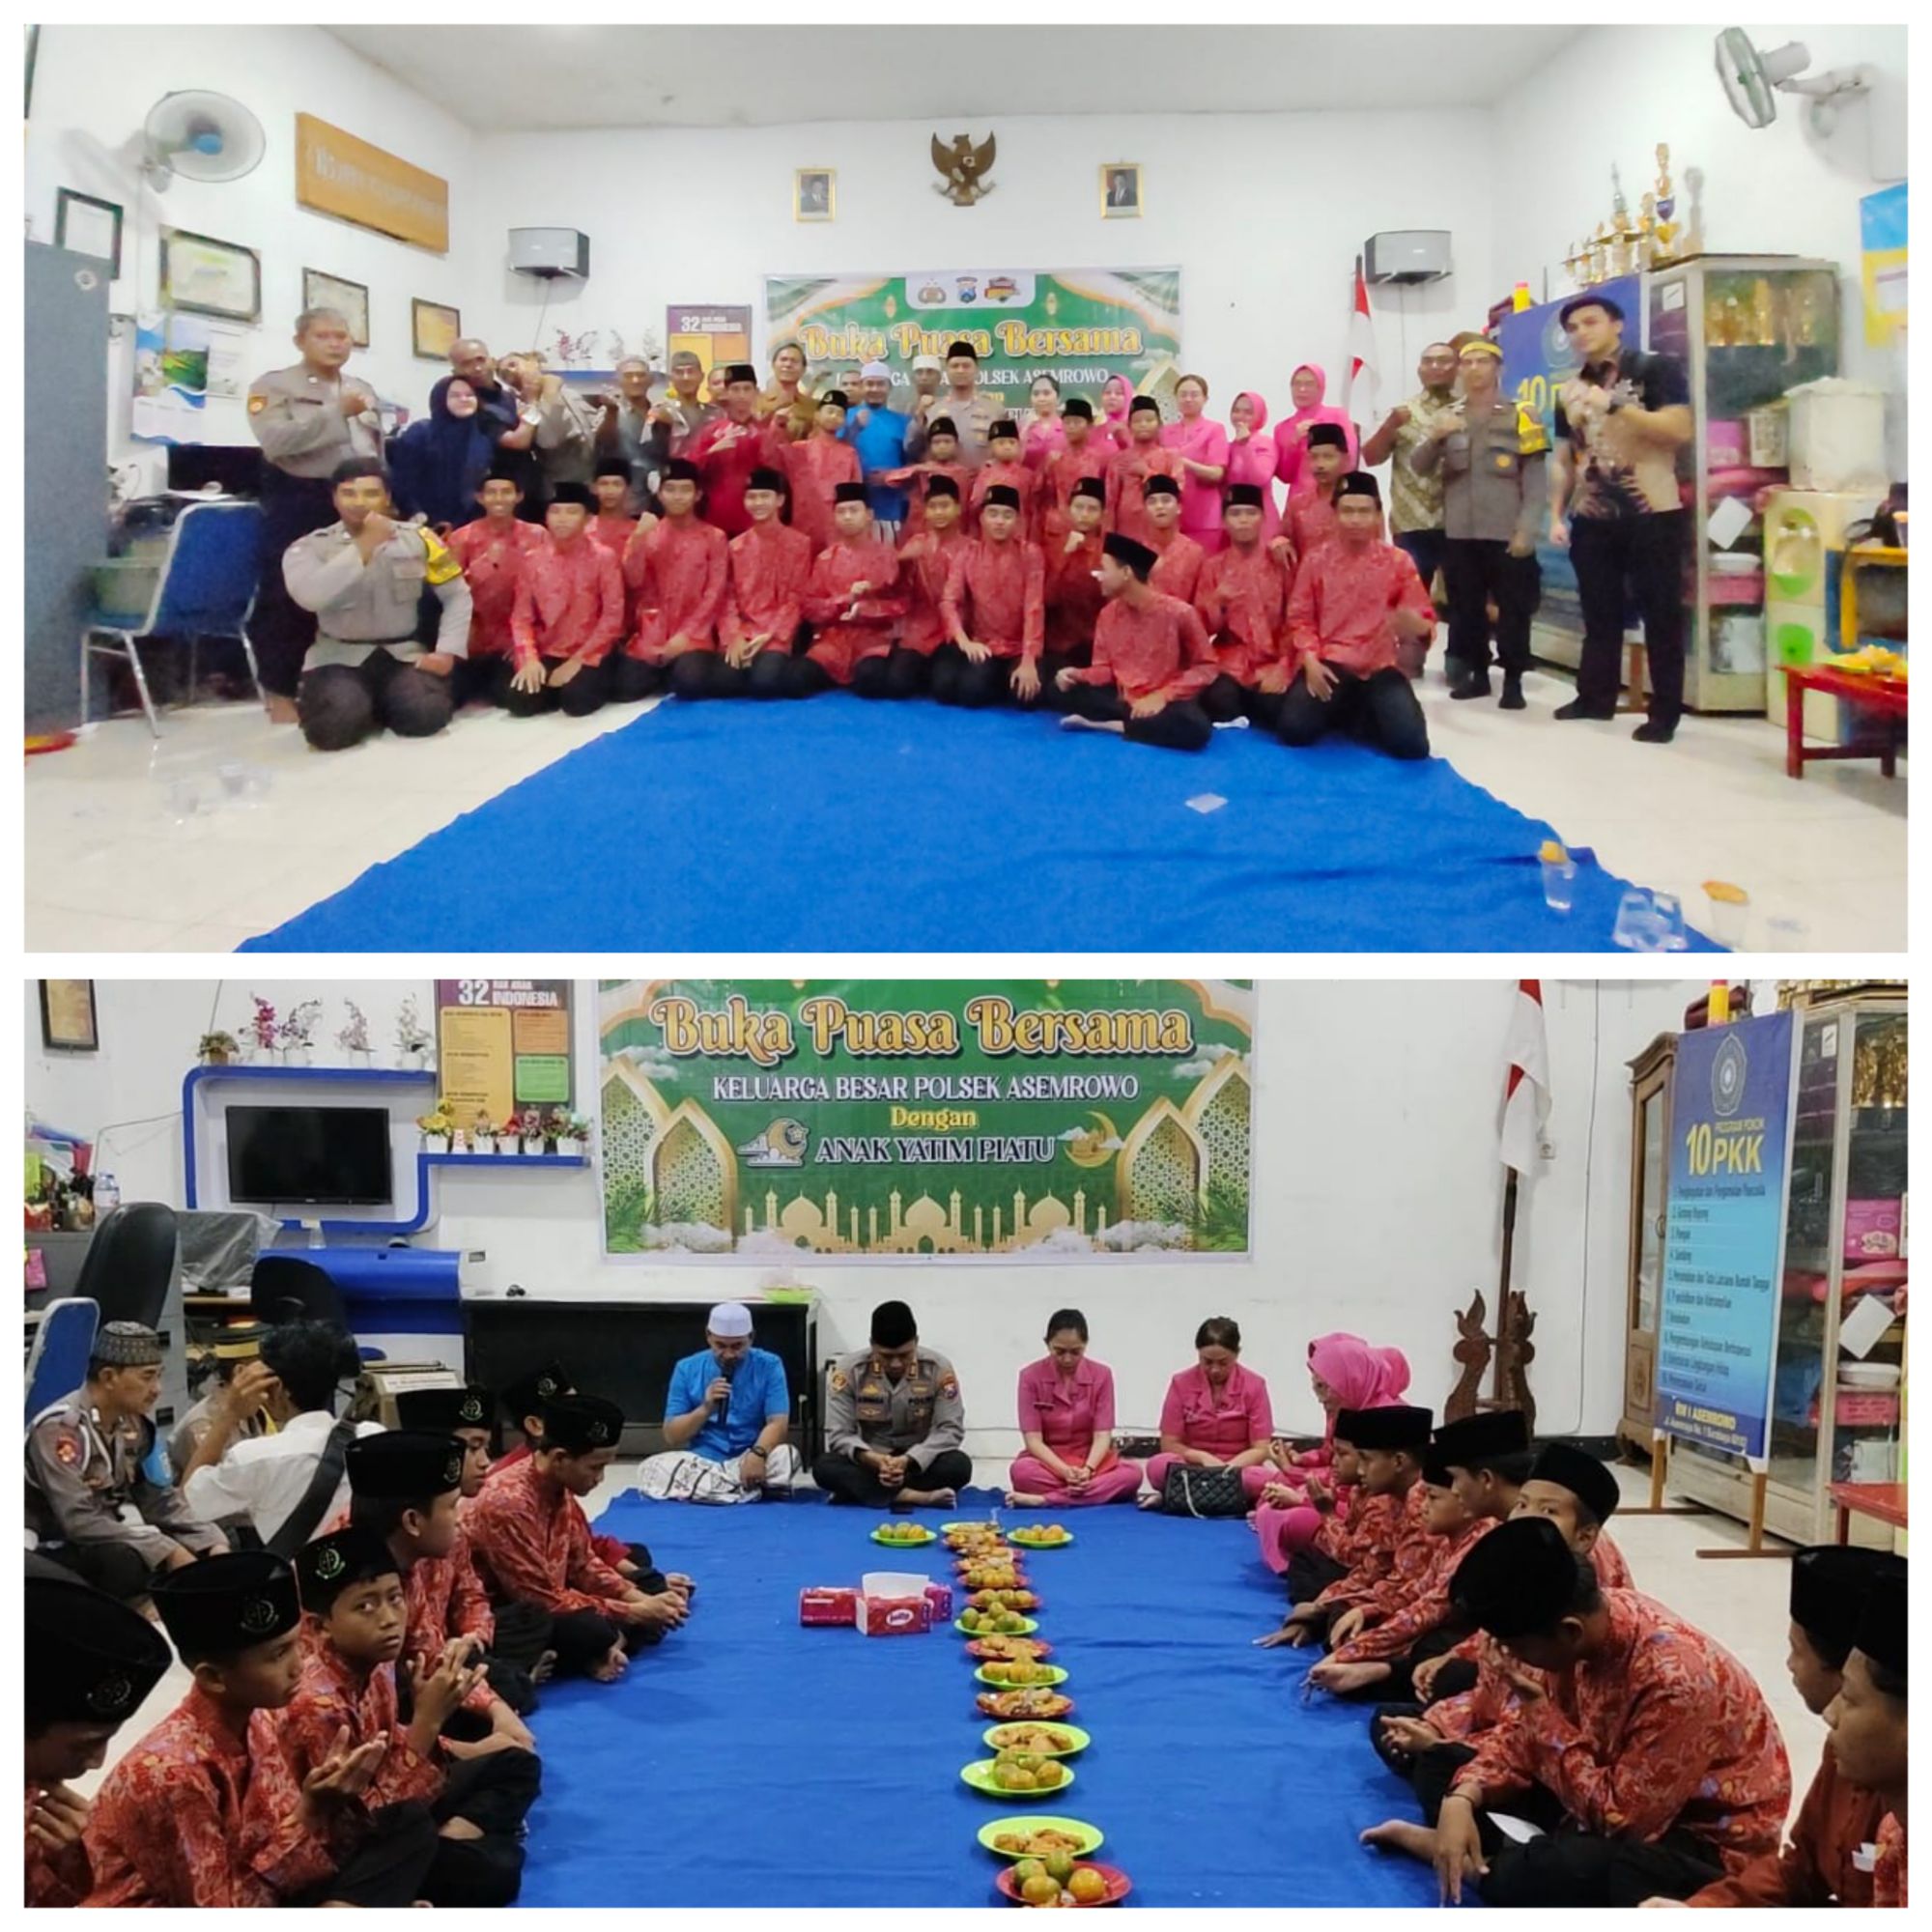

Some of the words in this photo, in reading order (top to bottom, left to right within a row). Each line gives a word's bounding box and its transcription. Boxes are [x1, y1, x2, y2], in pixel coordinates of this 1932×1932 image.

[681, 317, 699, 332] 32
[799, 323, 887, 363] Buka
[995, 320, 1142, 356] Bersama
[975, 369, 1018, 384] OLSEK
[459, 980, 489, 1005] 32
[492, 991, 557, 1006] INDONESIA
[649, 995, 795, 1065] Buka
[799, 996, 959, 1055] Puasa
[964, 995, 1194, 1054] Bersama
[713, 1077, 830, 1100] KELUARGA
[836, 1077, 908, 1100] BESAR
[914, 1076, 1001, 1099] POLSEK
[1006, 1075, 1139, 1099] ASEMROWO
[890, 1106, 978, 1131] Dengan
[814, 1136, 891, 1164] ANAK
[893, 1136, 973, 1163] YATIM
[976, 1136, 1056, 1163] PIATU
[1686, 1123, 1712, 1175] 10
[1712, 1135, 1765, 1175] PKK
